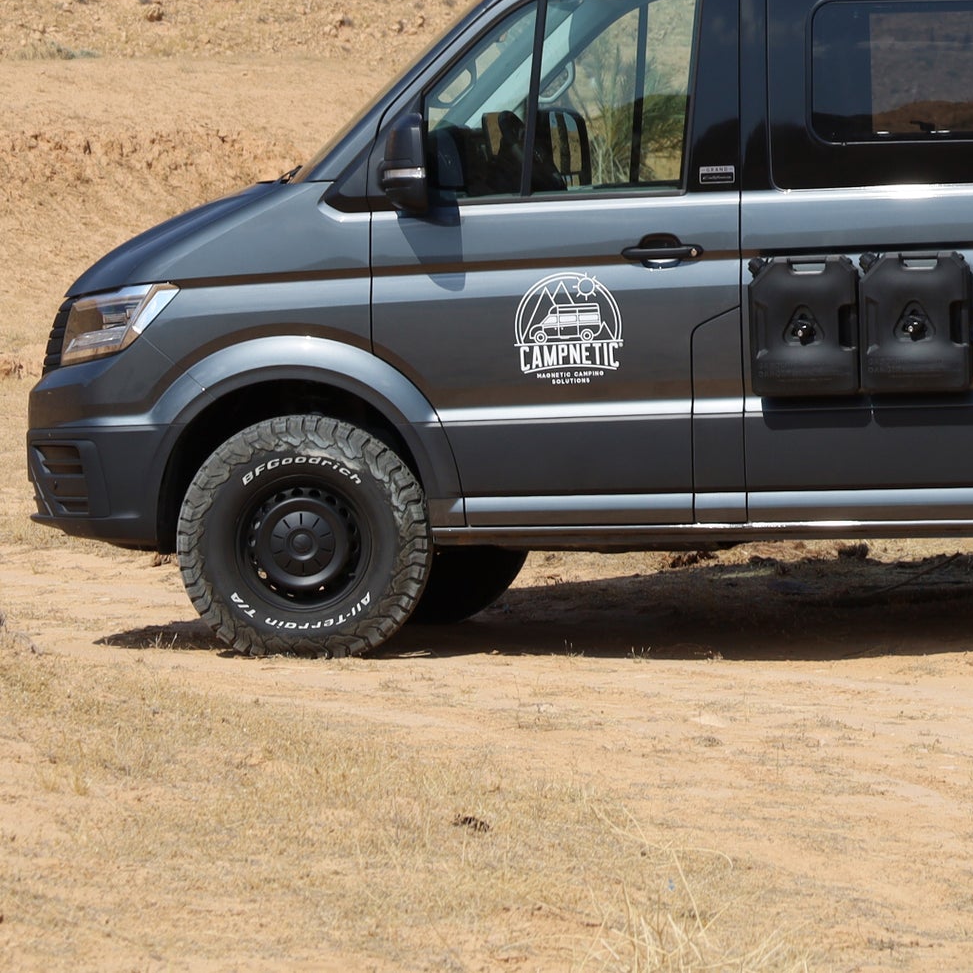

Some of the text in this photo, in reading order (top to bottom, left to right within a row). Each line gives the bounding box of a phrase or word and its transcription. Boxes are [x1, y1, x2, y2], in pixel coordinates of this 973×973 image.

[536, 371, 571, 379] MAGNETIC
[551, 377, 591, 385] SOLUTIONS
[242, 455, 362, 487] BFGoodrich
